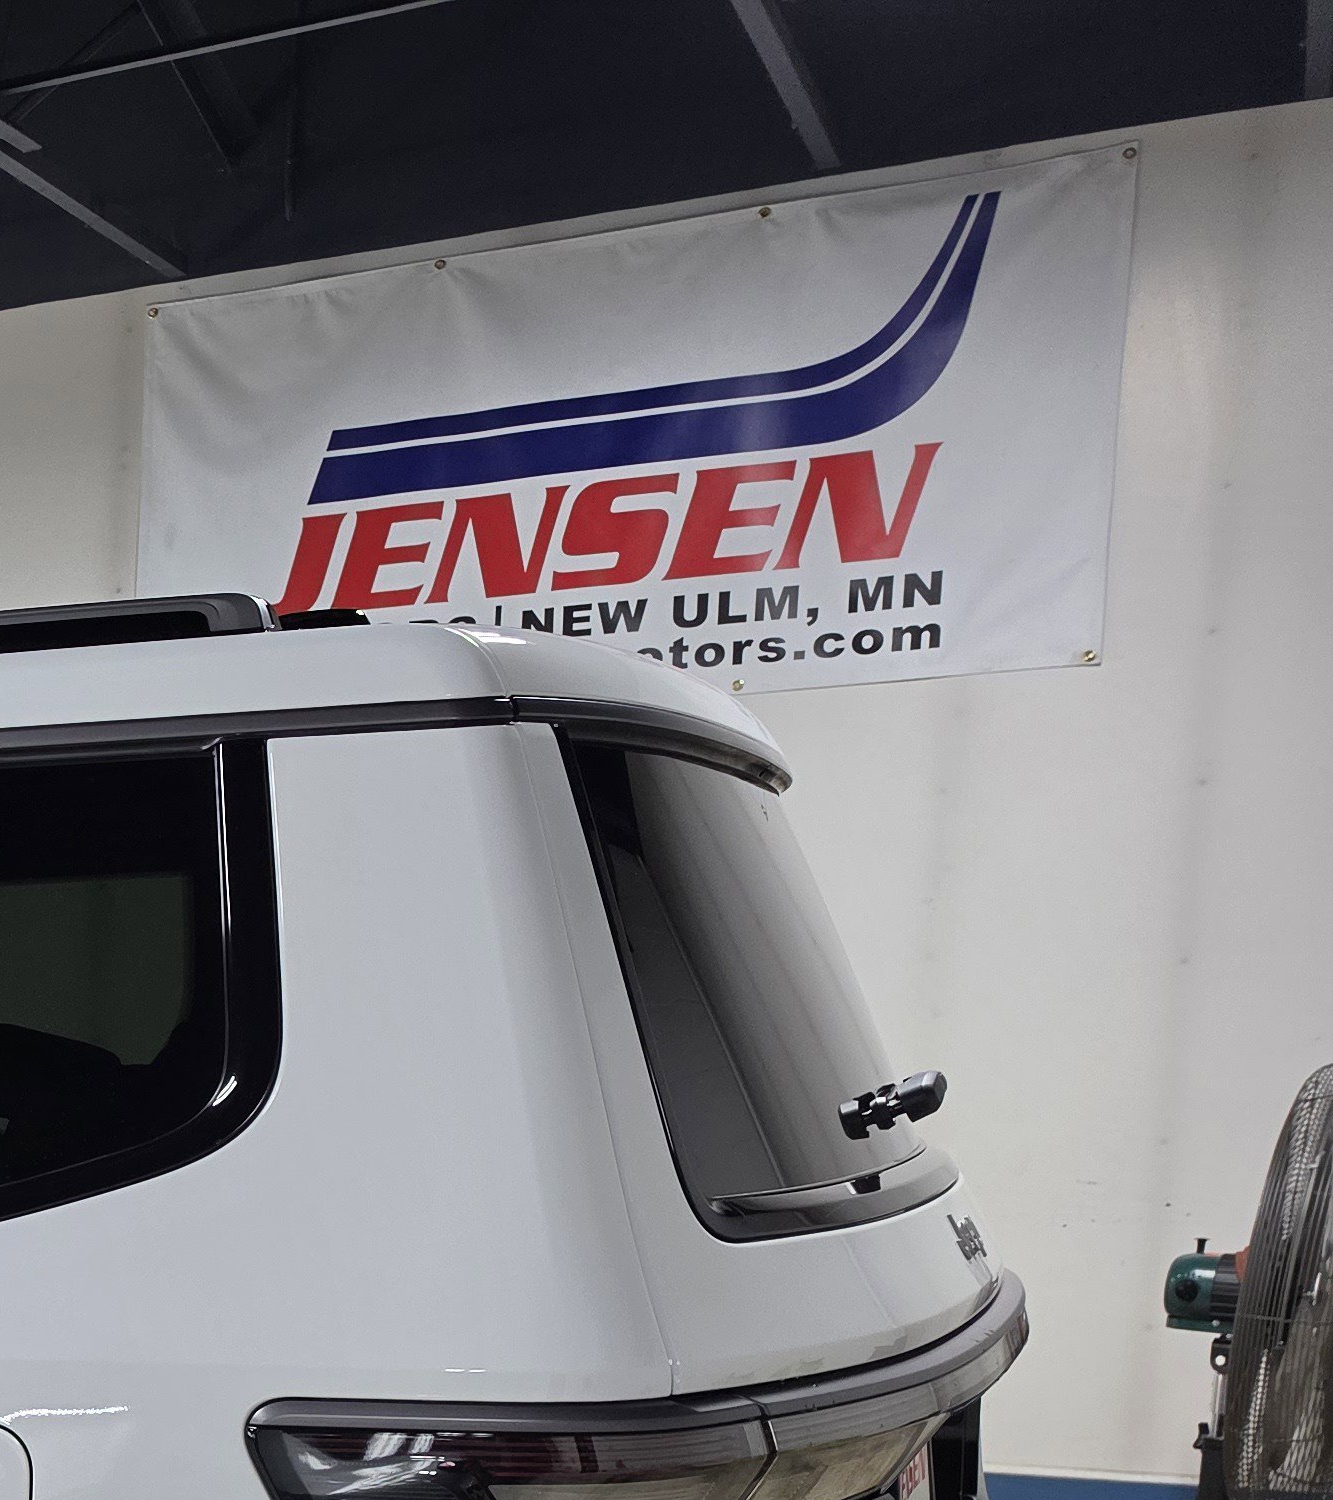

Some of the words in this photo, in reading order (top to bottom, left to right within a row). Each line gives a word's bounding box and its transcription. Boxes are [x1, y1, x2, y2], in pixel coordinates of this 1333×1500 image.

[276, 442, 944, 610] JENSEN
[521, 598, 648, 637] NEW
[672, 585, 819, 628] ULM,
[848, 570, 943, 613] MN
